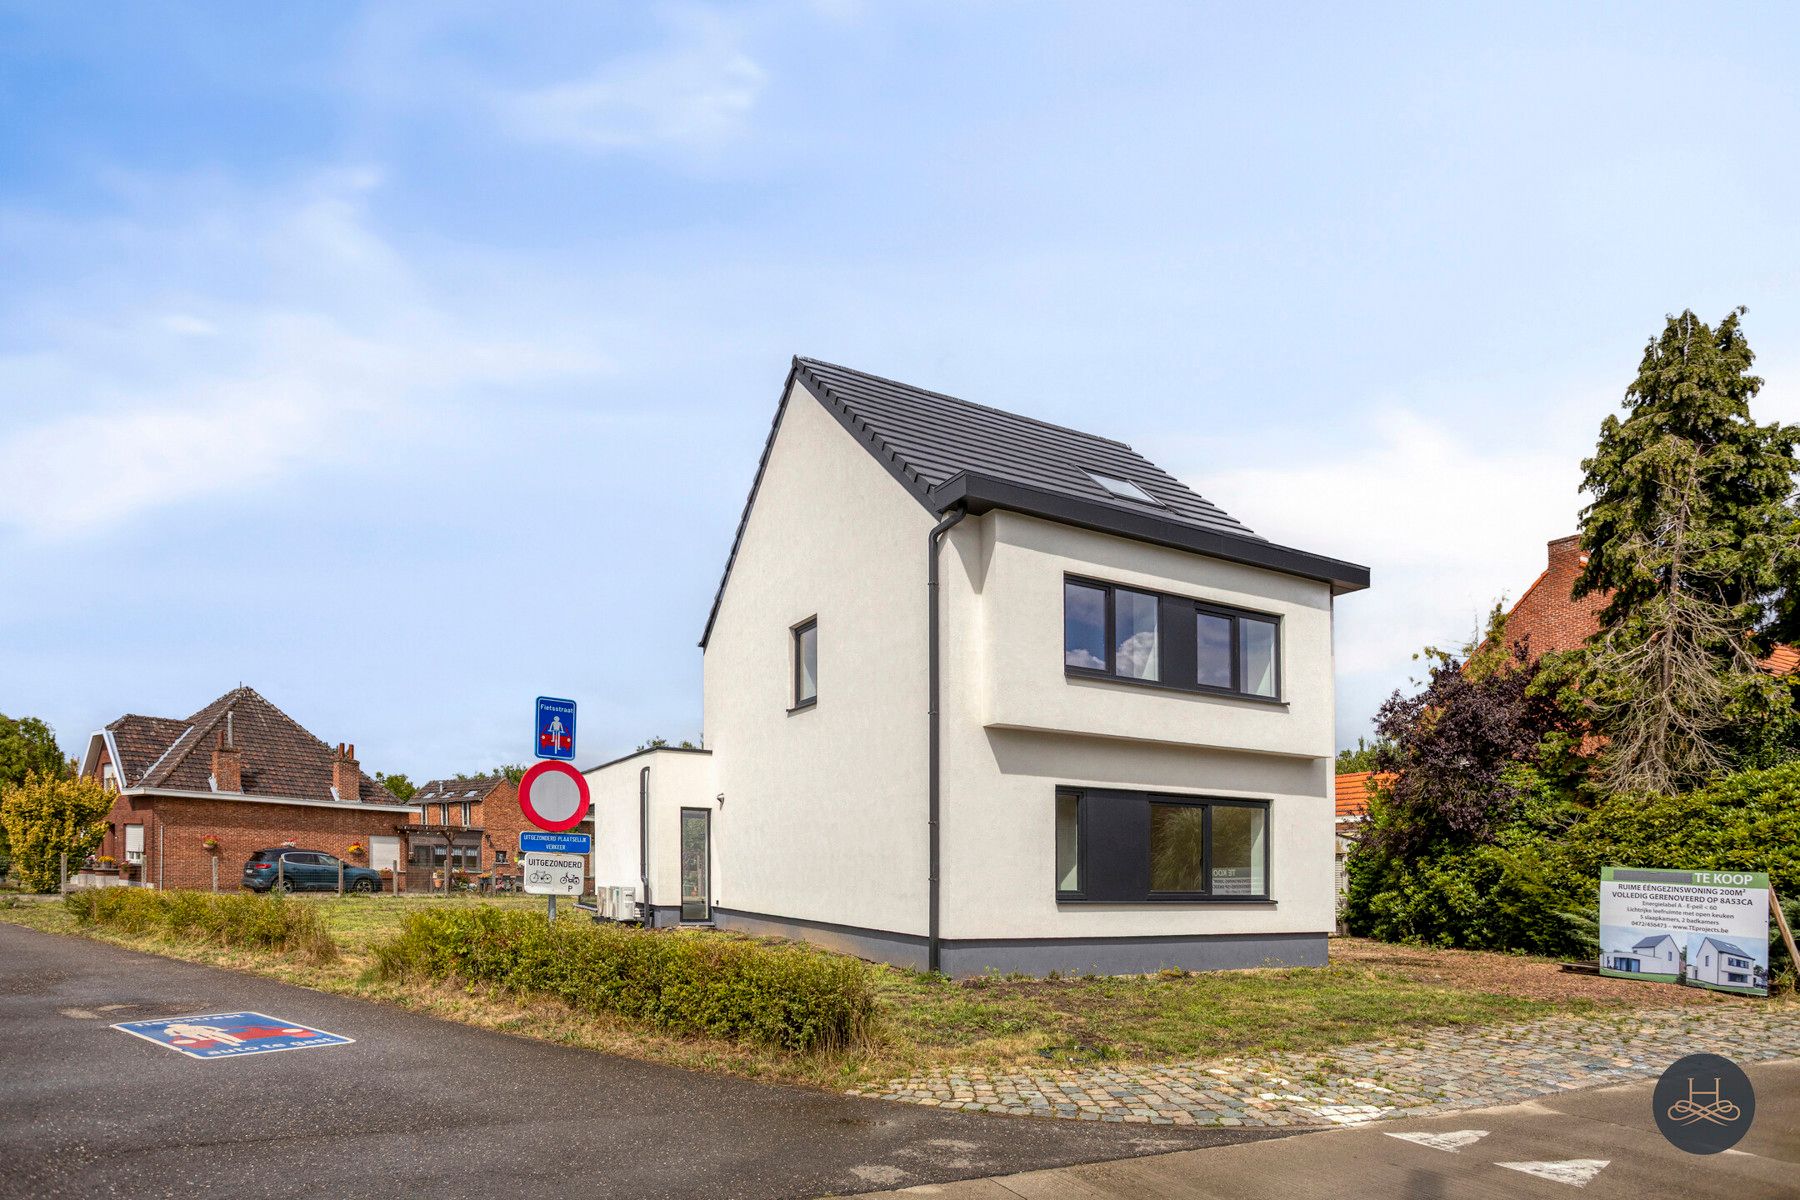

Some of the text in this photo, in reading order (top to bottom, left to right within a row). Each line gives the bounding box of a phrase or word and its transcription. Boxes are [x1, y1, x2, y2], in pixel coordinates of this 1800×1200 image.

[540, 703, 575, 714] Fietsstraat
[523, 834, 556, 842] UITGEZONDERD
[528, 858, 582, 869] UITGEZONDERD
[1694, 872, 1753, 885] TE KOOP
[1618, 883, 1641, 891] RUIME
[1612, 891, 1648, 900] VOLLEDIG
[1648, 893, 1706, 903] GERENOVEERD
[1706, 896, 1718, 904] OP
[1686, 917, 1720, 926] badkamers
